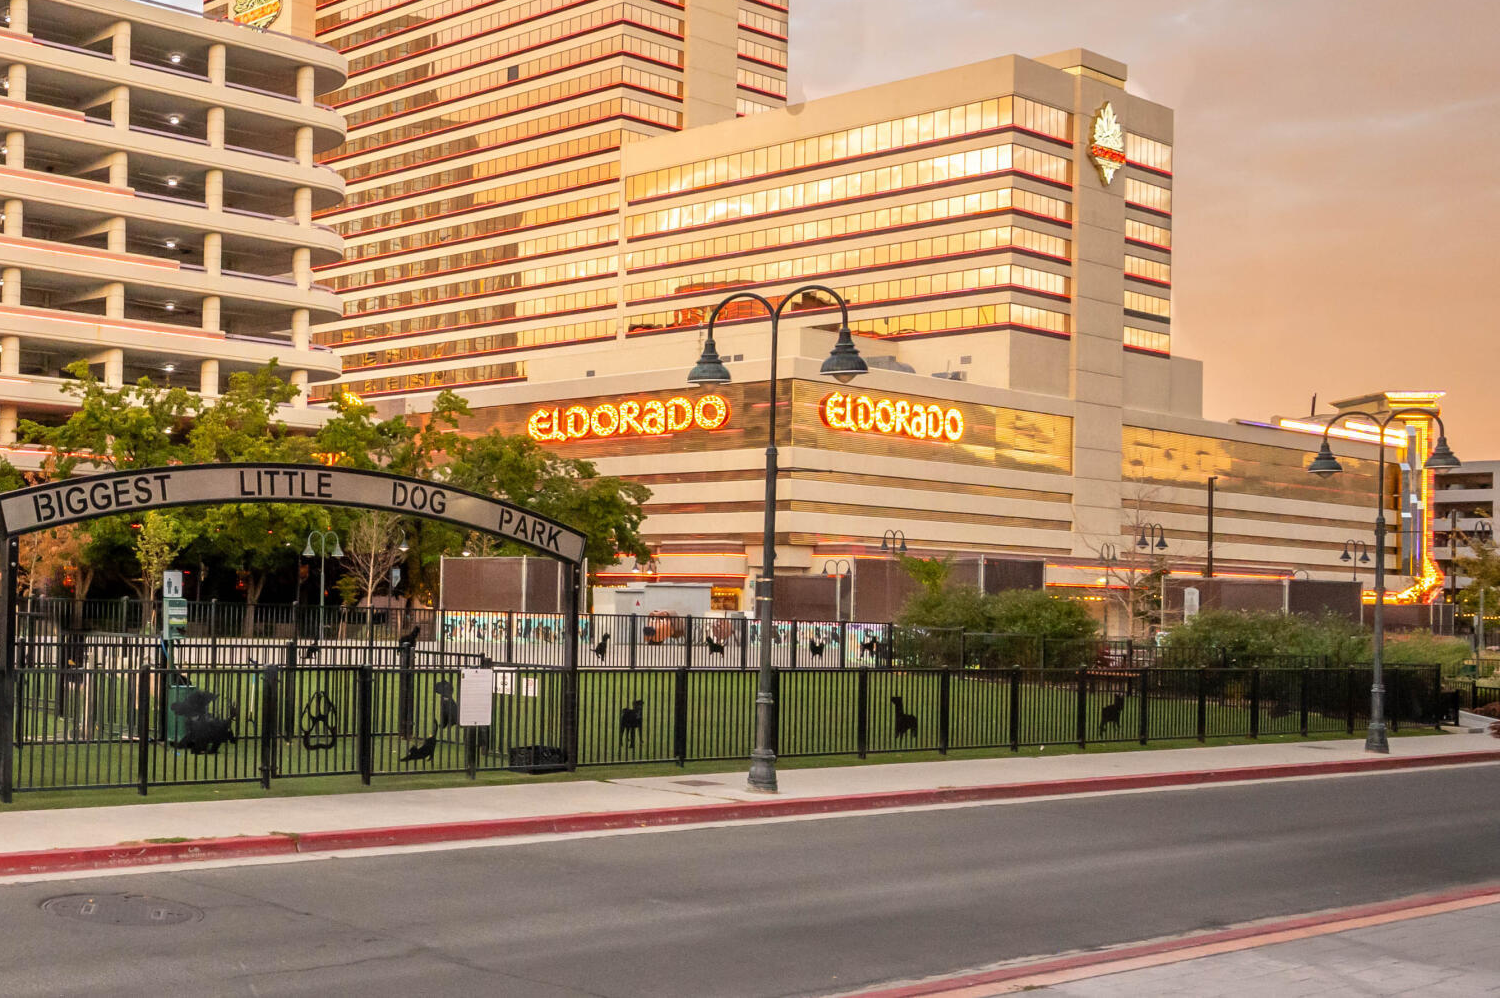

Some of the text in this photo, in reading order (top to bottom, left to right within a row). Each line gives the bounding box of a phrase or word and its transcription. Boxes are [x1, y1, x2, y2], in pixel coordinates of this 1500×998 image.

[33, 470, 563, 552] BIGGEST LITTLE DOG PARK
